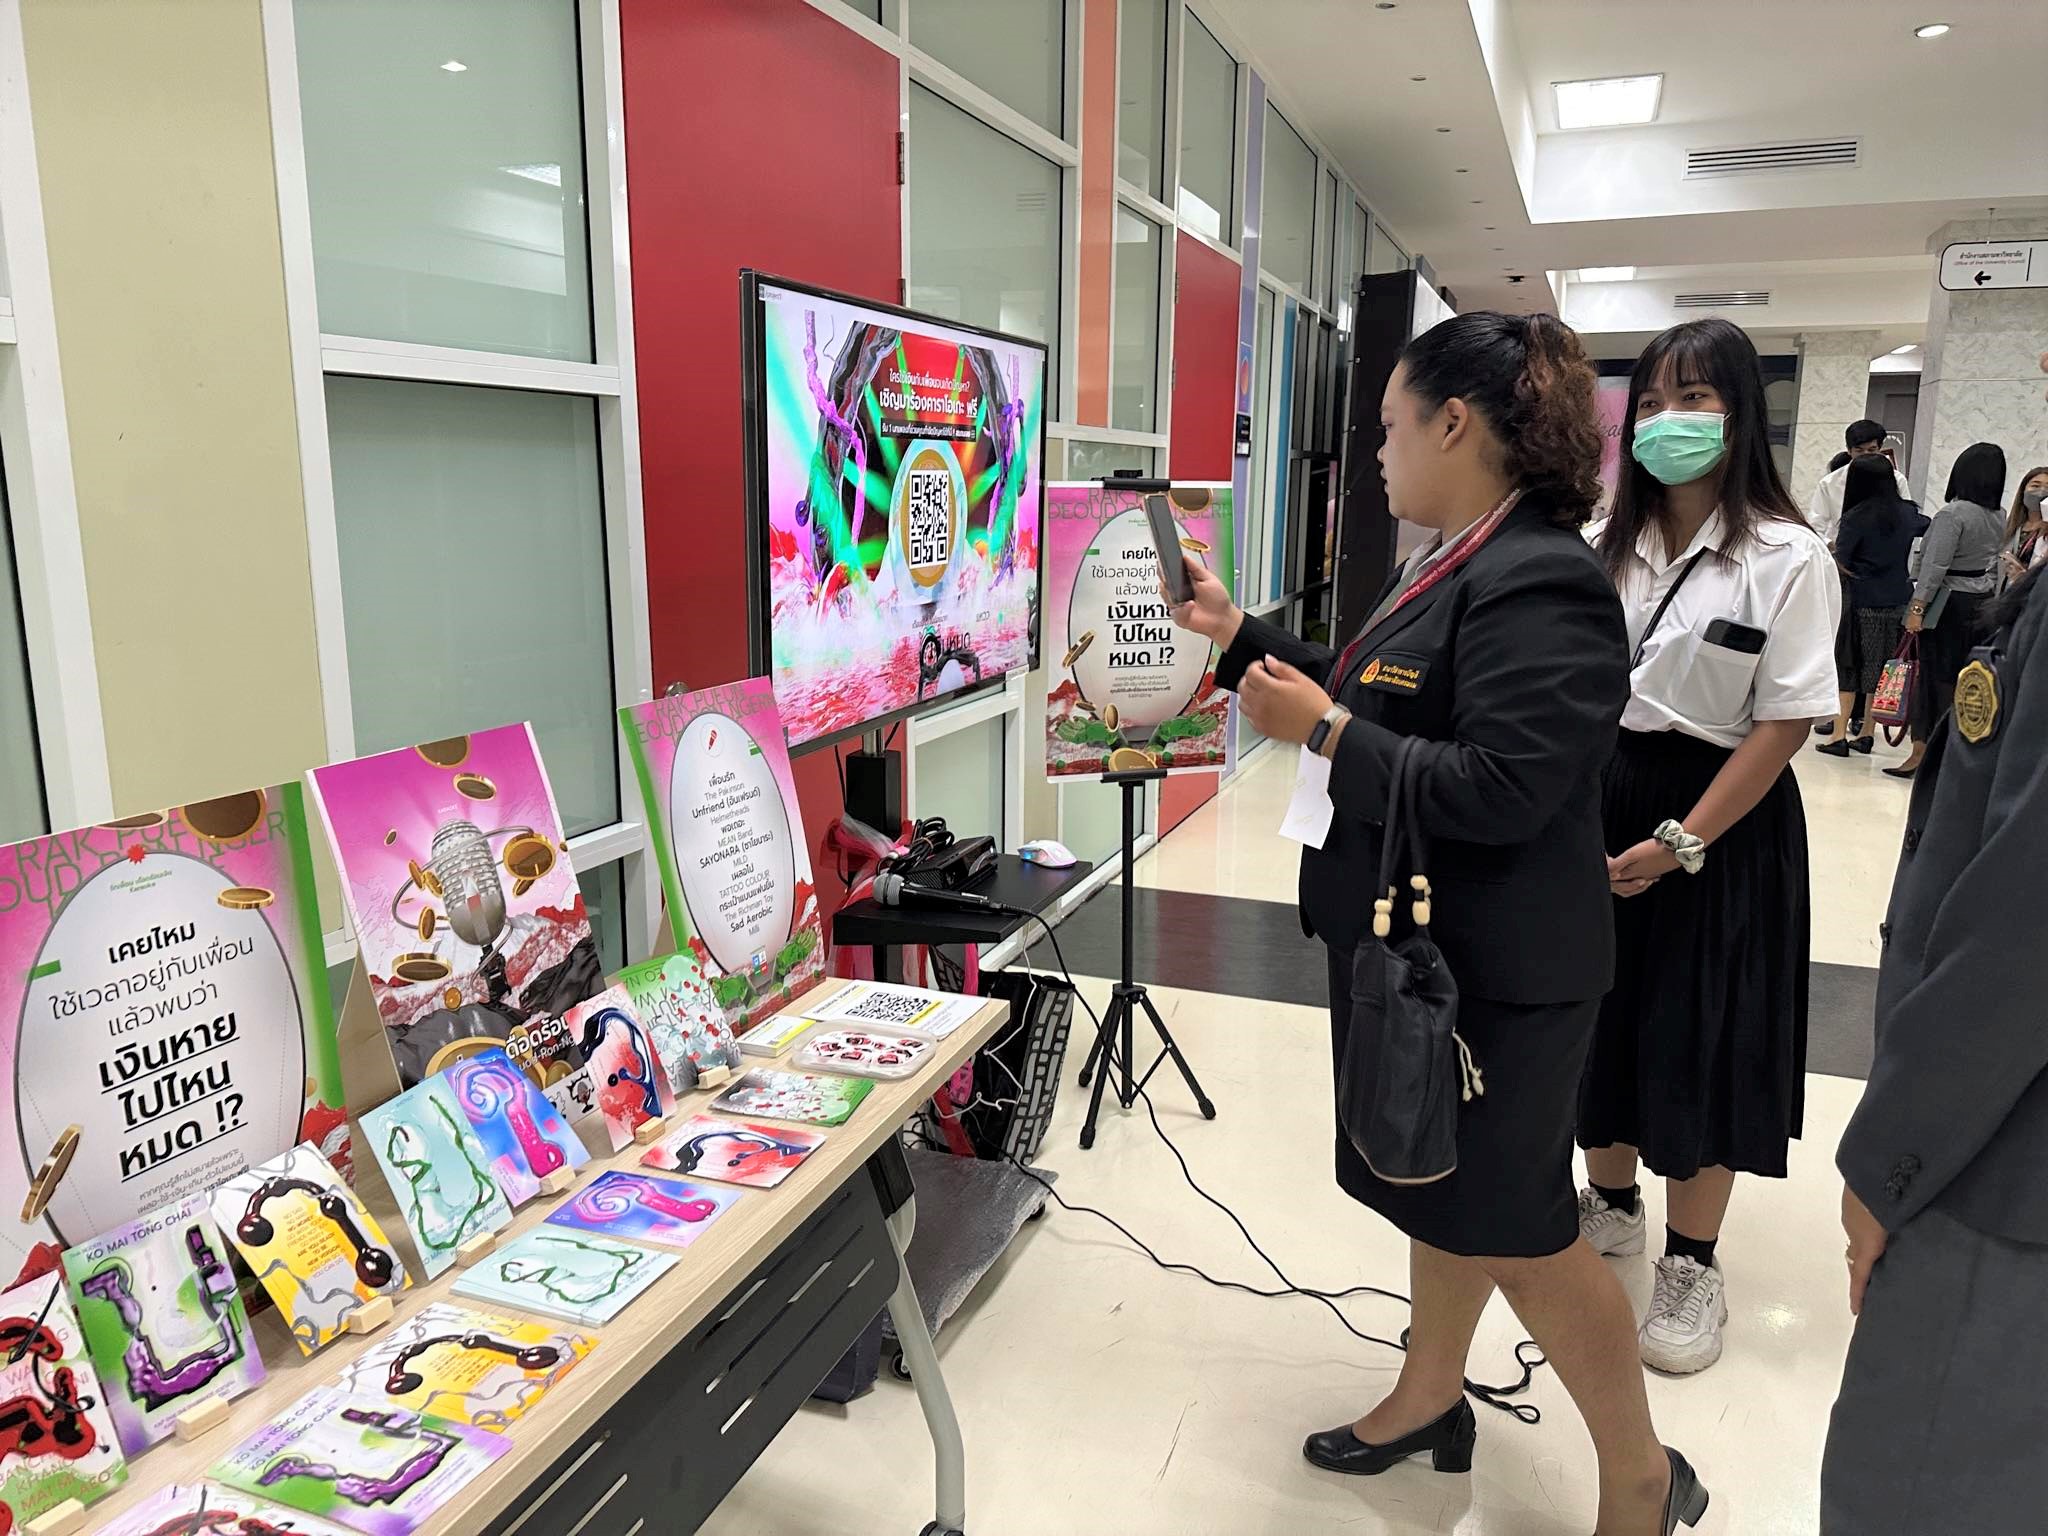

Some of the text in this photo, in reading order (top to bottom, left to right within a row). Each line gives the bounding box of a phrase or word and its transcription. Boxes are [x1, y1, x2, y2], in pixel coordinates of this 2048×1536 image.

[1122, 547, 1157, 560] เคยไห
[1092, 564, 1157, 581] ใช้เวลาอยู่กั
[1115, 582, 1159, 595] แล้วพบ
[1113, 623, 1171, 642] ไปไหน
[1109, 651, 1151, 667] หมด
[692, 798, 725, 818] Unfriend
[699, 844, 740, 869] SAYONARA
[719, 869, 770, 899] TATTOO COLOUR
[731, 906, 773, 933] Sad Aerobic
[108, 921, 196, 964] เคยไหม
[49, 936, 254, 1020] ใช้เวลาอยู่กับเพื่อน
[108, 980, 218, 1037] แล้วพบว่า
[99, 1012, 238, 1088] เงินหาย
[506, 1016, 569, 1060] ดือดร้อ
[117, 1060, 231, 1126] ไปไหน
[119, 1120, 203, 1178] หมด
[86, 1248, 103, 1263] KO
[106, 1238, 129, 1254] MAI
[130, 1221, 163, 1242] TONG
[165, 1208, 192, 1226] CHAI
